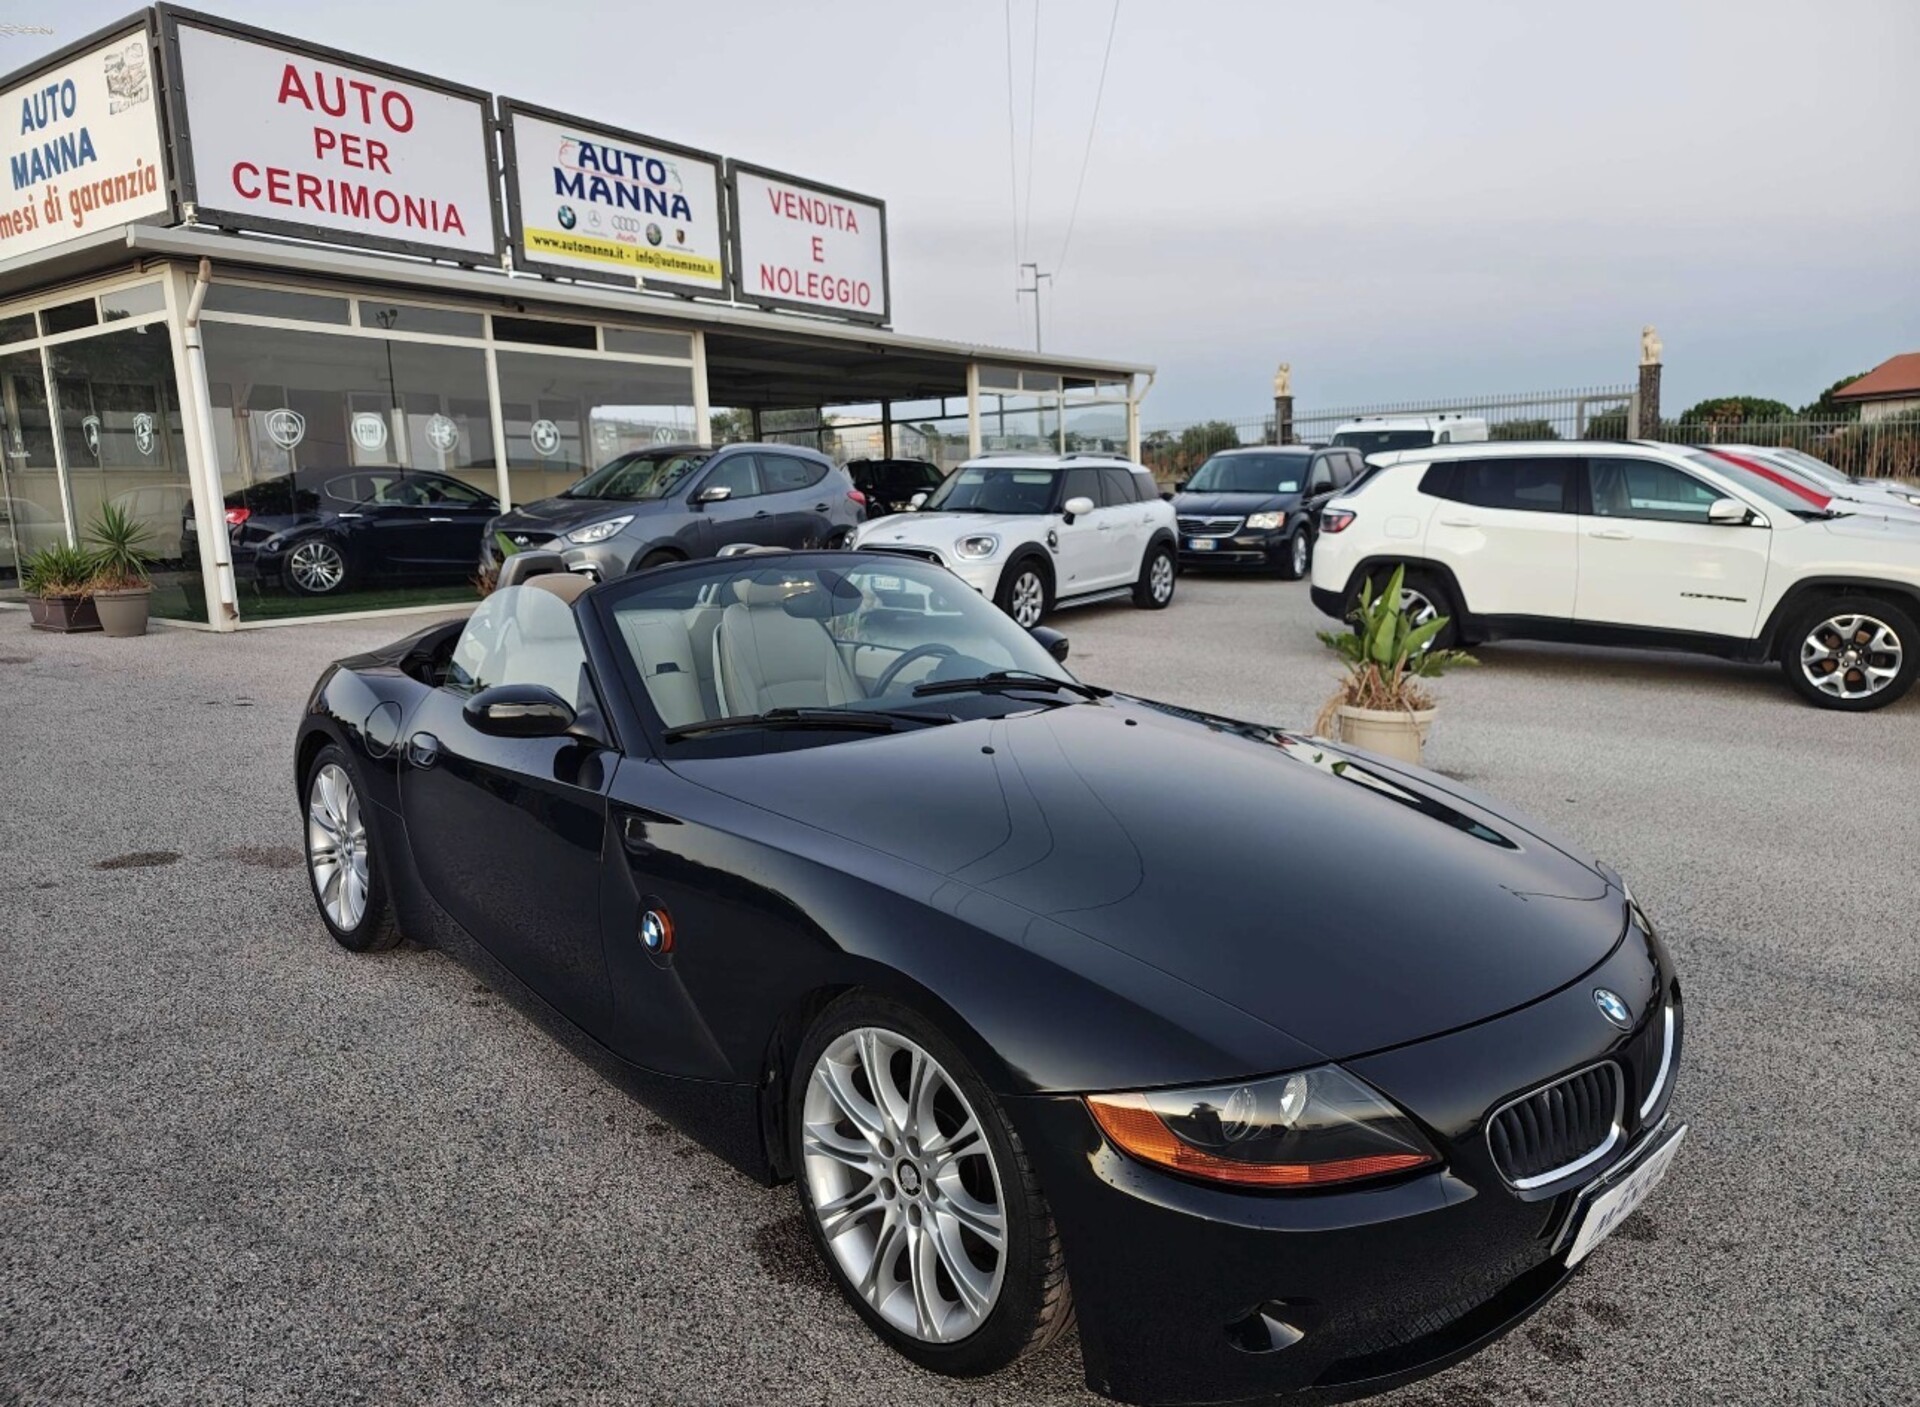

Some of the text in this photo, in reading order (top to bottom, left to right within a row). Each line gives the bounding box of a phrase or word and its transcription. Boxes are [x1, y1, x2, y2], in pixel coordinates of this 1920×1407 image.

[21, 78, 77, 136] AUTO
[278, 64, 415, 134] AUTO
[10, 127, 98, 190] MANNA
[313, 127, 392, 174] PER
[578, 141, 666, 185] AUTO
[0, 158, 157, 240] mesi di garanzia
[232, 162, 465, 237] CERIMONIA
[553, 167, 692, 222] MANNA
[767, 187, 859, 234] VENDITA
[532, 235, 624, 260] www.automanna.it
[635, 249, 715, 275] info@automanna.it
[812, 237, 824, 264] E
[760, 264, 871, 308] NOLEGGIO
